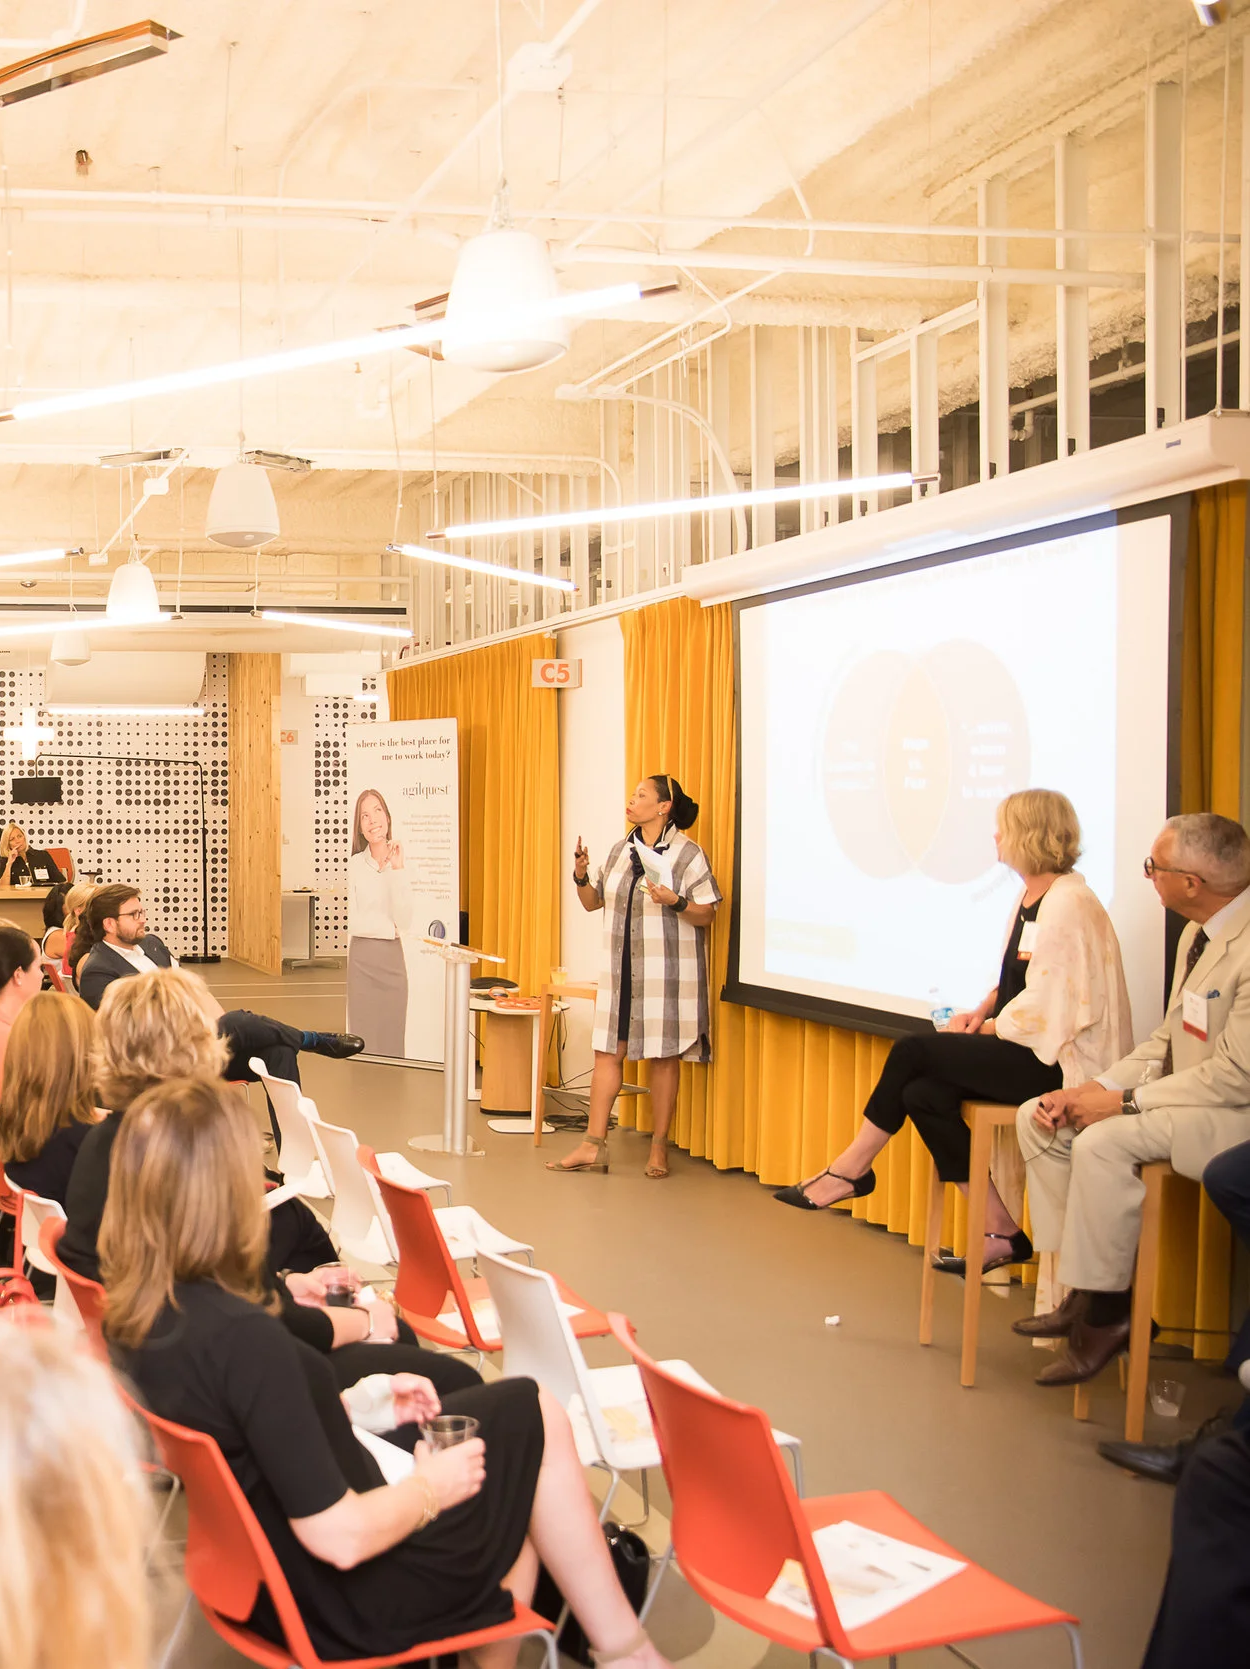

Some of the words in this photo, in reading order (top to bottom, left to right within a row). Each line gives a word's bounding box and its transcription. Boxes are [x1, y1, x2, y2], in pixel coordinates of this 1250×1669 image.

[540, 662, 570, 684] C5
[356, 740, 378, 748] where
[379, 739, 385, 747] is
[387, 738, 399, 747] the
[400, 737, 416, 746] best
[417, 737, 437, 748] place
[439, 736, 451, 745] for
[404, 750, 424, 760] work
[425, 750, 451, 761] today?
[402, 782, 448, 799] agilquest
